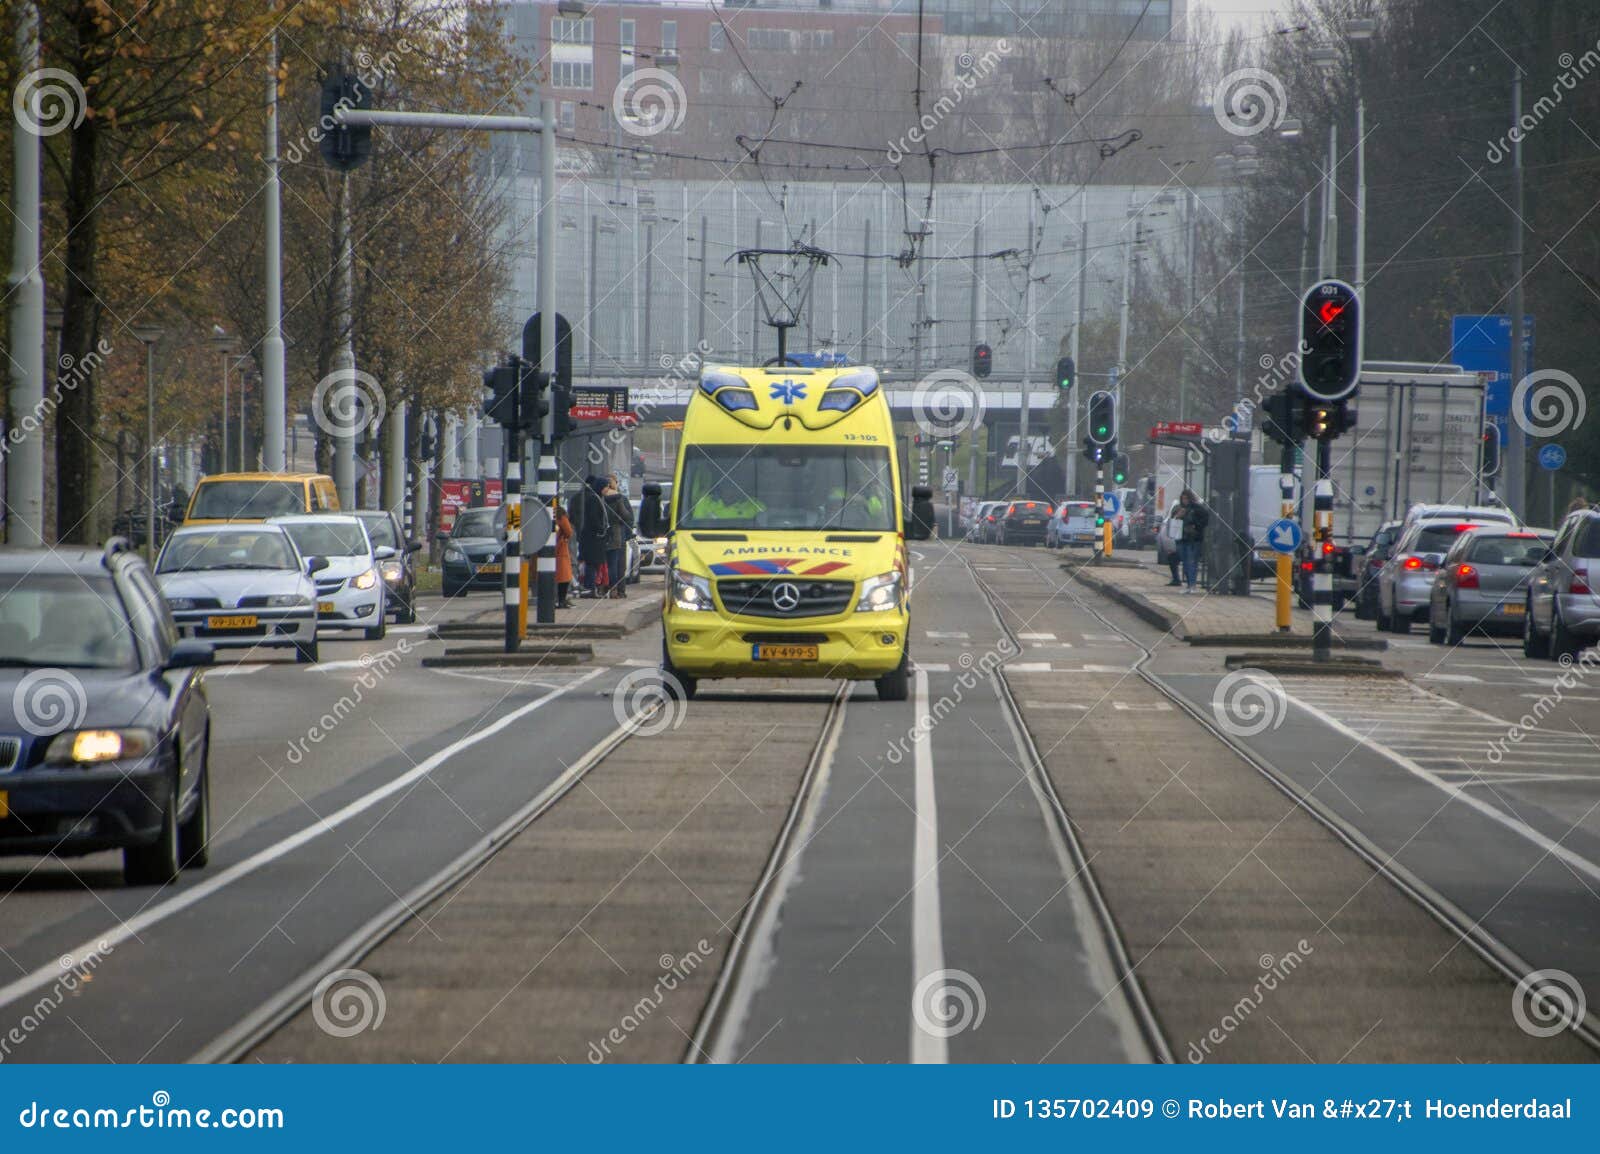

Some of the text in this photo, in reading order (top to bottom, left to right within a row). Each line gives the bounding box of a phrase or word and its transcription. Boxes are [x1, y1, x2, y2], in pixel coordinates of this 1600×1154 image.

[844, 433, 878, 442] 13-105
[722, 546, 853, 557] AMBULANCE
[762, 646, 815, 659] KV-499-S
